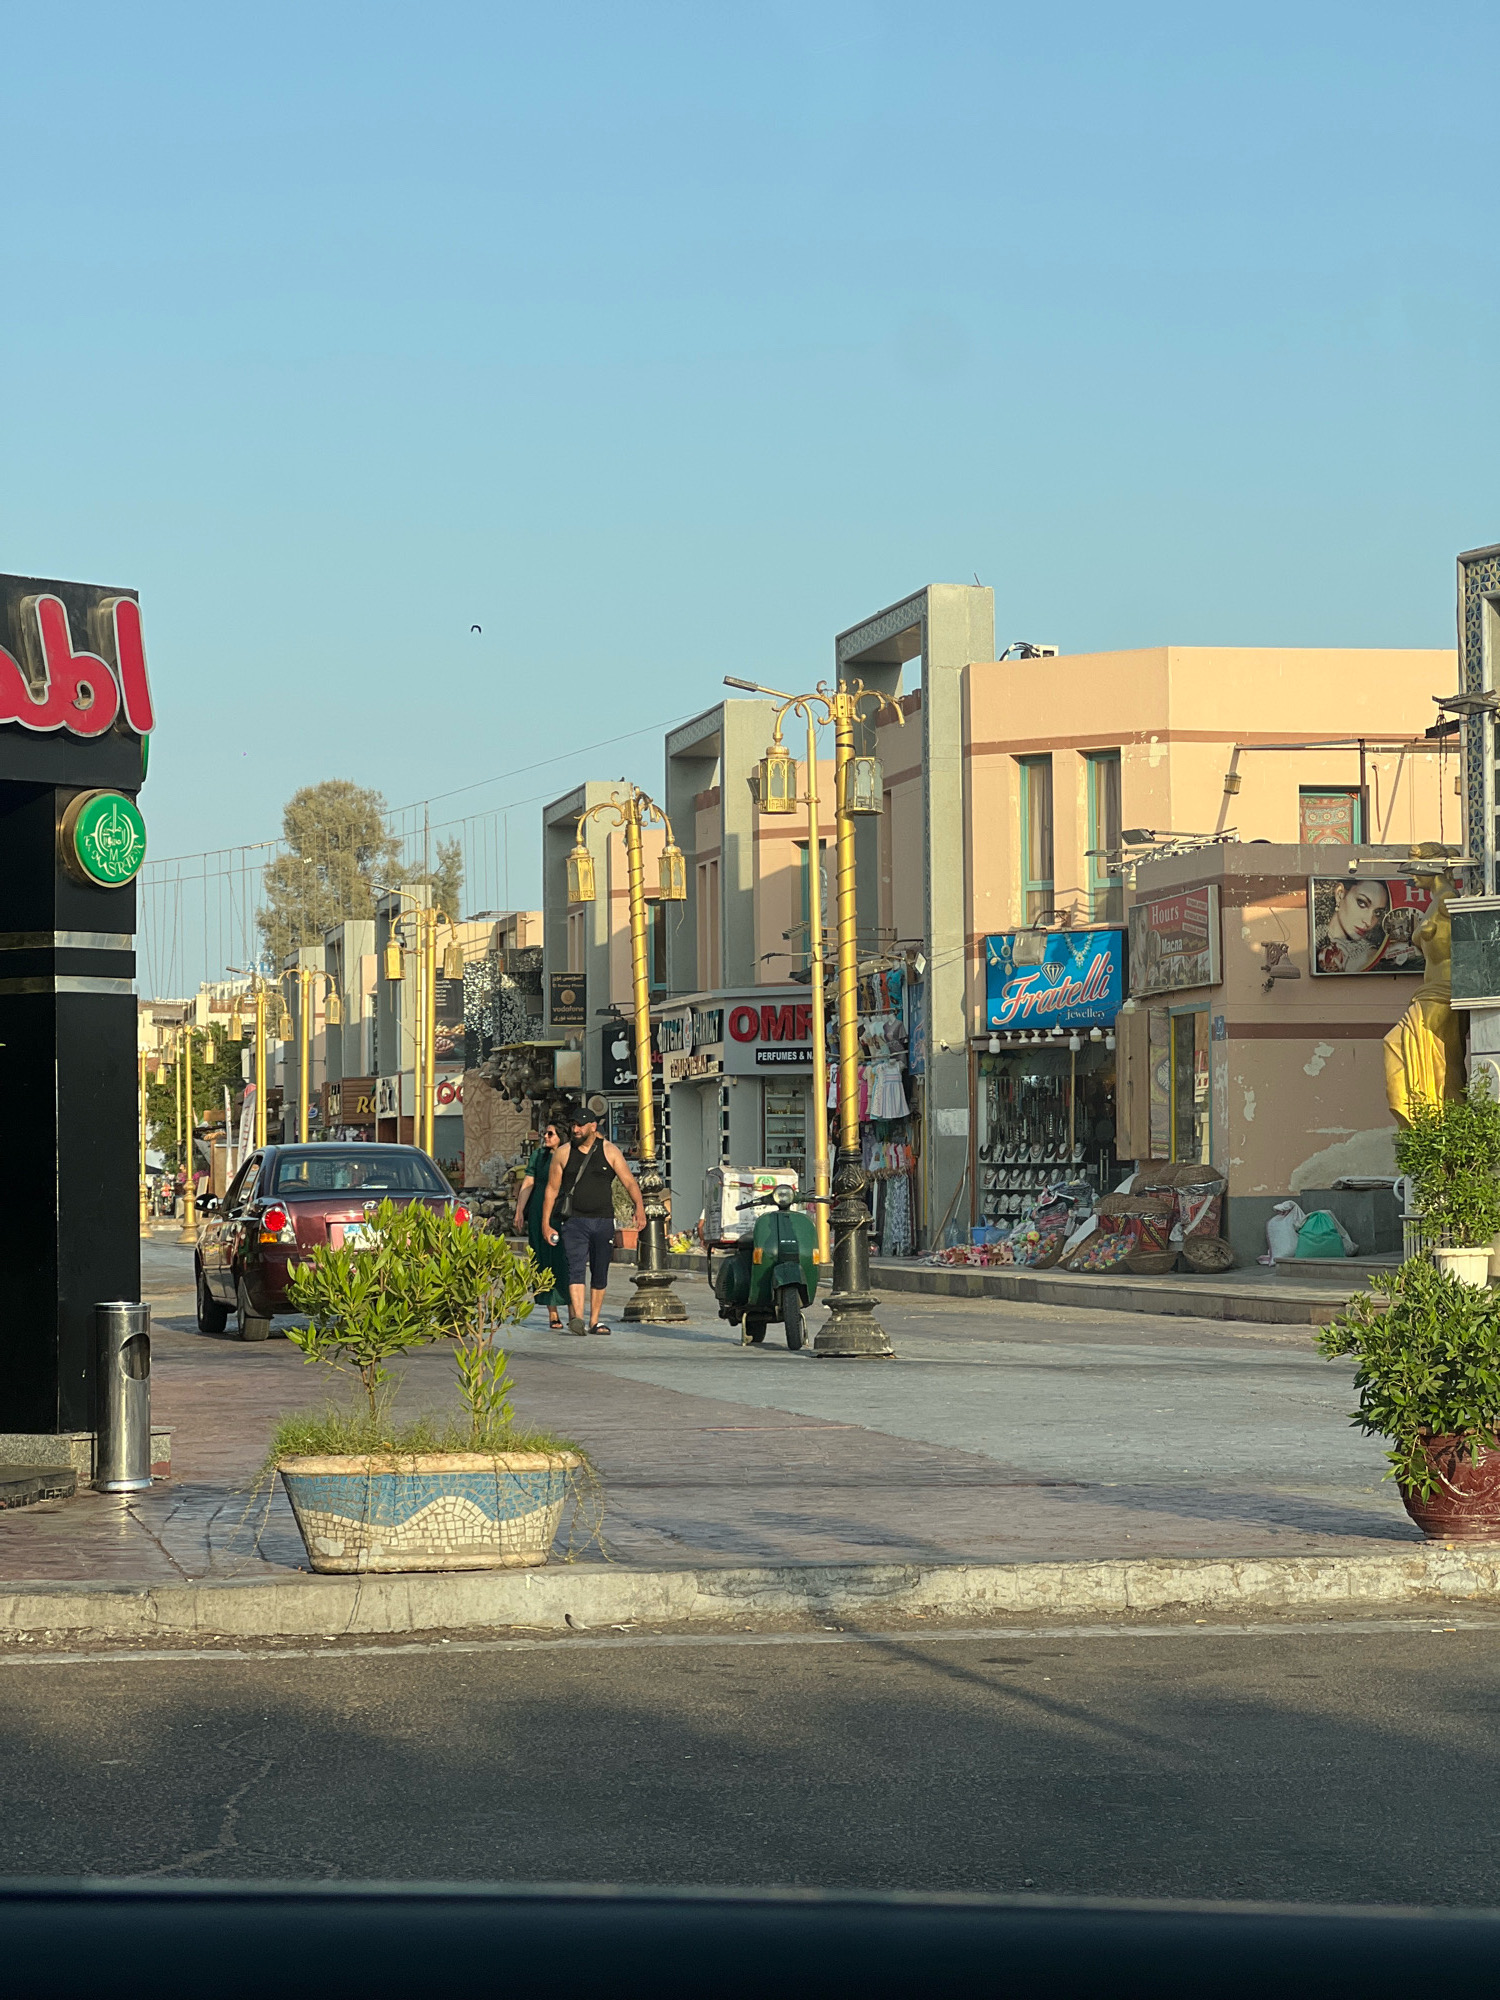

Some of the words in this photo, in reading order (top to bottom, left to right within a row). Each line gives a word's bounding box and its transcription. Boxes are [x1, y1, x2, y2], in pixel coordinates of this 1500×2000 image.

[1151, 905, 1180, 926] Hours
[992, 951, 1114, 1025] Fratelli
[757, 1051, 797, 1060] PERFUMES
[799, 1051, 805, 1060] &
